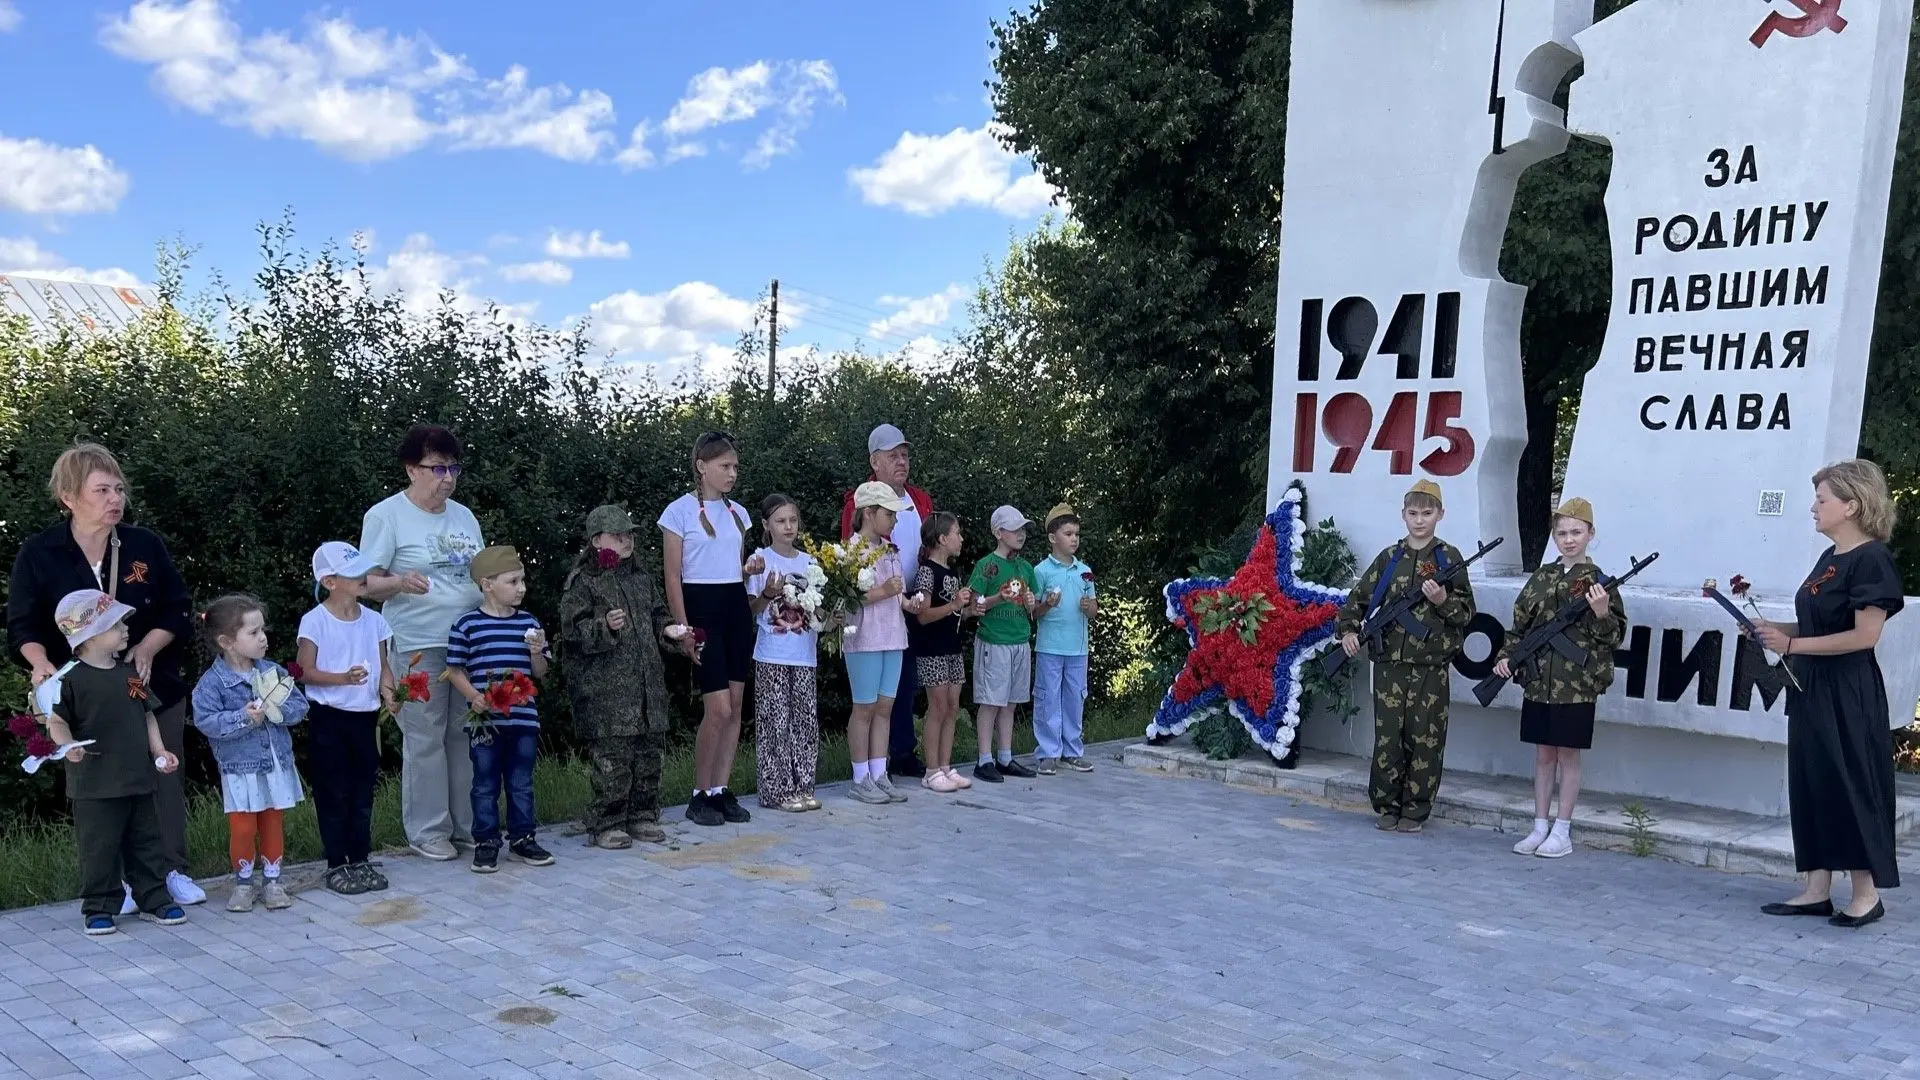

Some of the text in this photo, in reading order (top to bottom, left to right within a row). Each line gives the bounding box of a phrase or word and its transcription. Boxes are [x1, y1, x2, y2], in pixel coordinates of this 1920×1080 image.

[1704, 144, 1758, 188] ЗА
[1634, 200, 1829, 255] РОДИНУ
[1628, 265, 1829, 315] ПАВШИМ
[1297, 291, 1461, 382] 1941
[1634, 329, 1810, 373] ВЕЧНАЯ
[1292, 390, 1475, 476] 1945
[1640, 392, 1791, 431] СЛАВА
